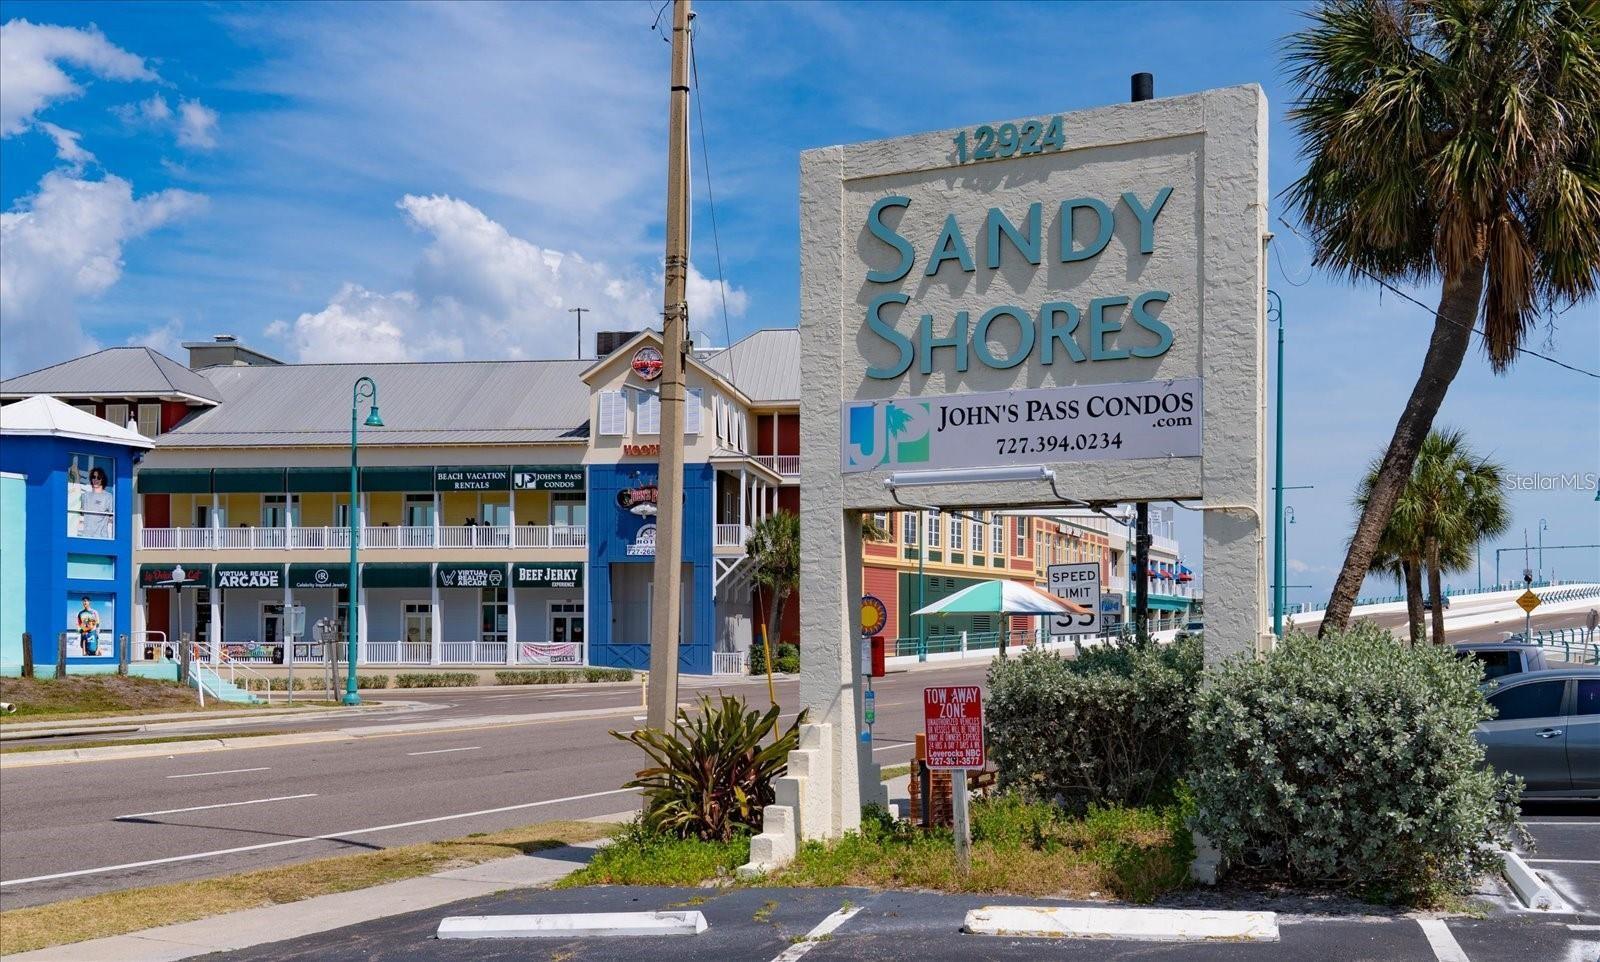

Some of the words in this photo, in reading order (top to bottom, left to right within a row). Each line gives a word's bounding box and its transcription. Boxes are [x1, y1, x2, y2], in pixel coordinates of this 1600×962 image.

[952, 115, 1066, 163] 12924
[866, 186, 1174, 284] SANDY
[866, 290, 1174, 379] SHORES
[937, 404, 1019, 432] JOHN'S
[1026, 399, 1079, 422] PASS
[1087, 392, 1194, 418] CONDOS
[1152, 415, 1193, 428] .com
[624, 445, 660, 456] HOOT
[996, 432, 1123, 455] 727.394.0234
[219, 576, 279, 587] ARCADE
[519, 568, 543, 581] BEEF
[544, 568, 577, 581] JERKY
[1052, 571, 1096, 582] SPEED
[1057, 588, 1091, 598] LIMIT
[926, 688, 947, 704] TOW
[952, 688, 978, 703] AWAY
[940, 703, 967, 718] ZONE
[928, 749, 964, 757] Leverocks
[965, 749, 981, 757] NBC
